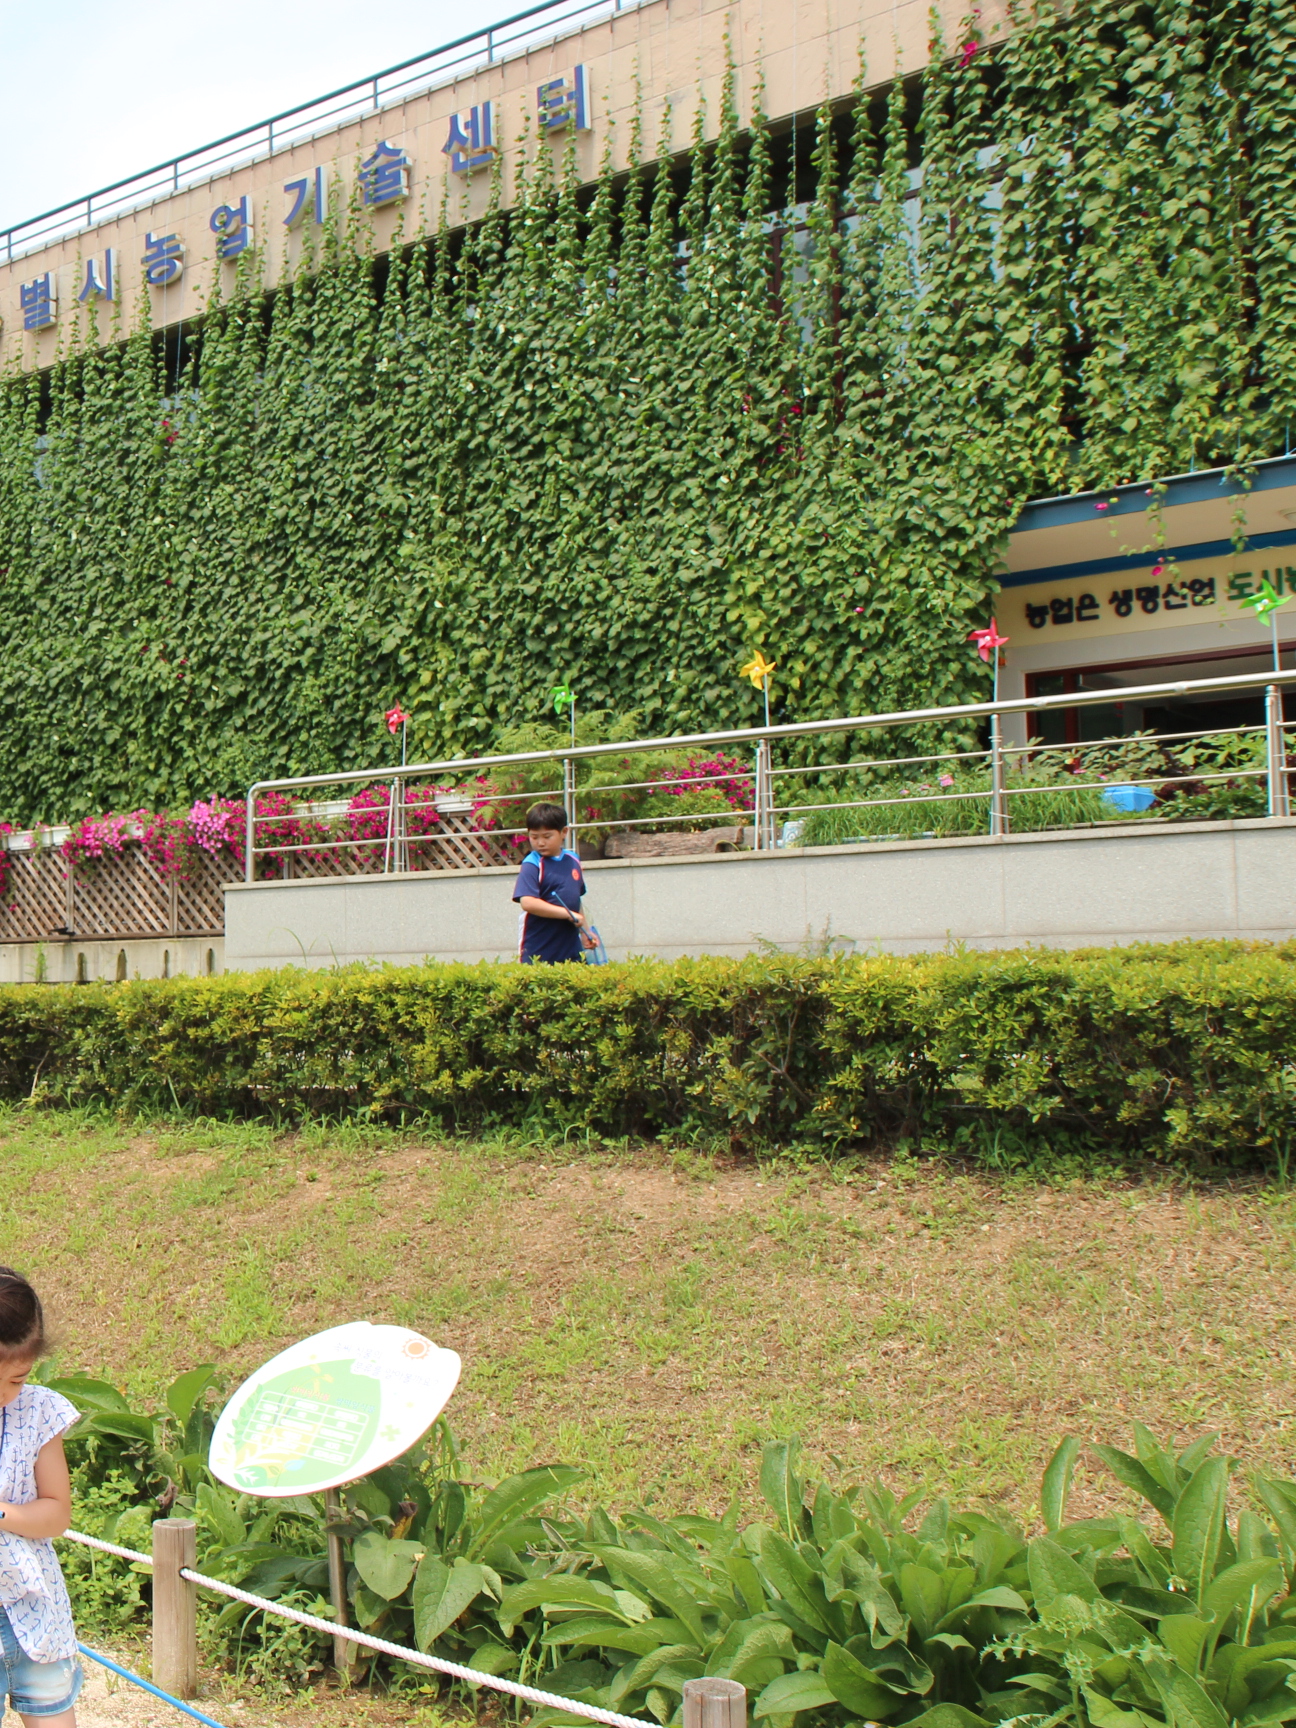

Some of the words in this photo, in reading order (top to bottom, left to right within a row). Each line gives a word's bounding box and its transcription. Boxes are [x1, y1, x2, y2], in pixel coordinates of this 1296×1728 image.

[1025, 592, 1100, 629] 농업은
[1108, 577, 1217, 618] 생명산업
[353, 1360, 382, 1377] 분류를
